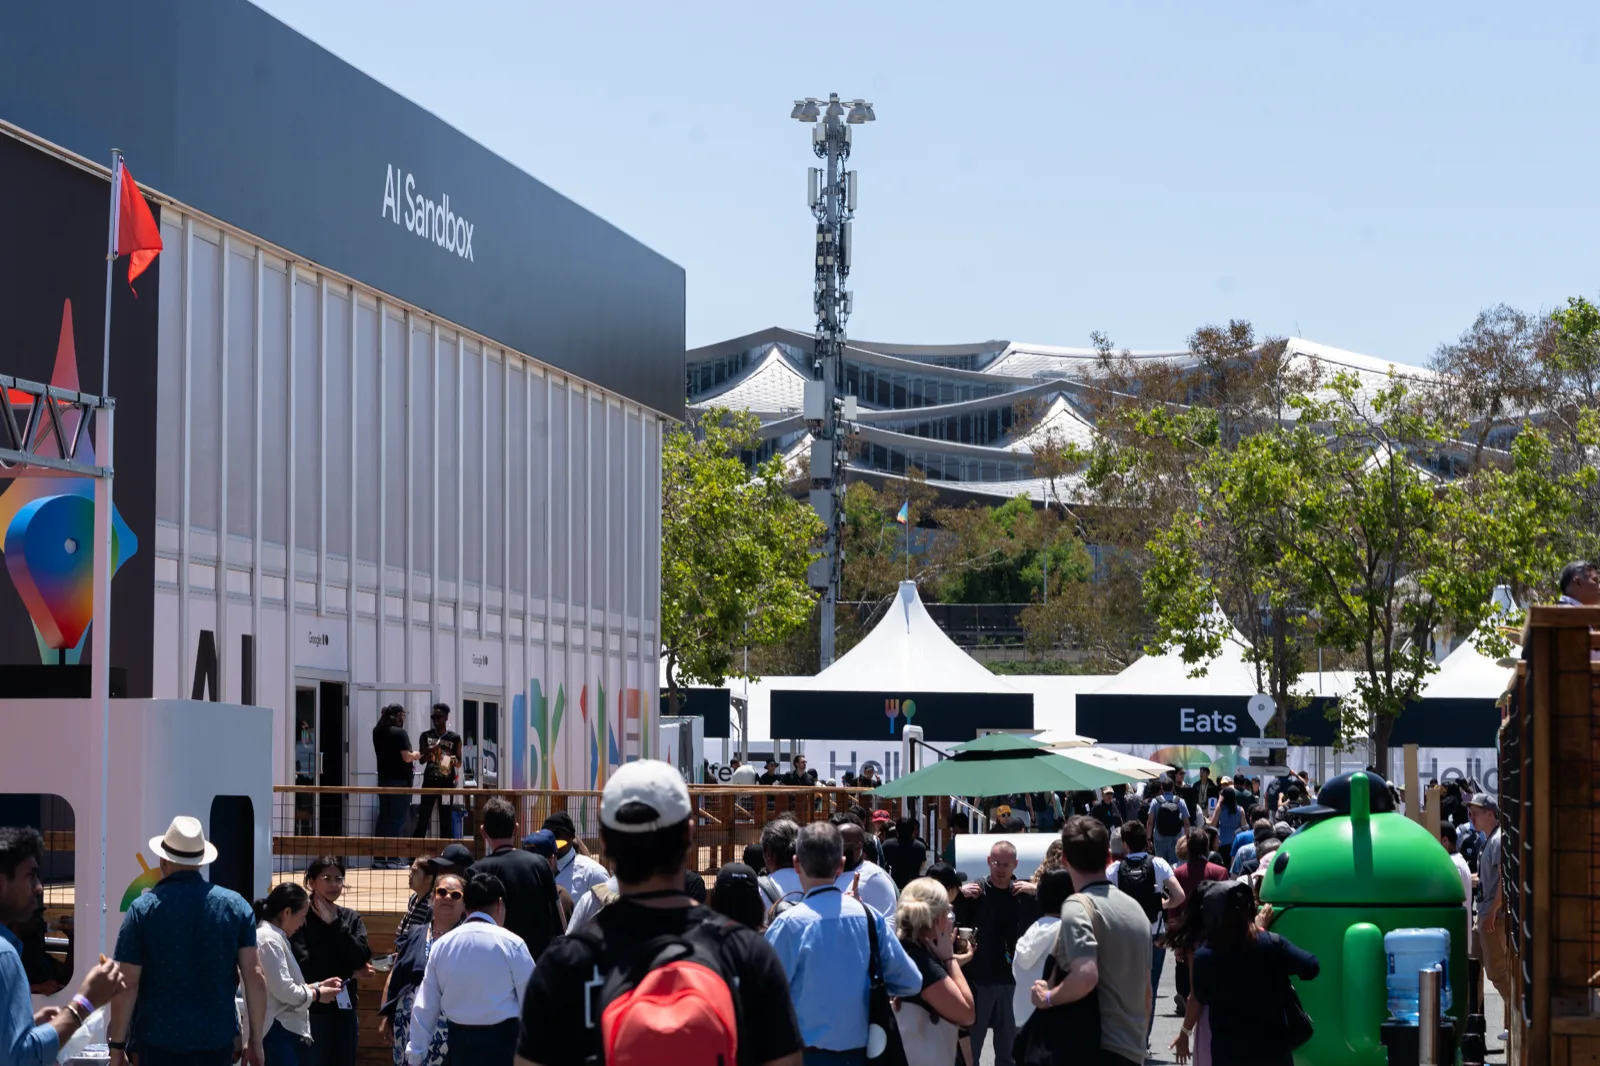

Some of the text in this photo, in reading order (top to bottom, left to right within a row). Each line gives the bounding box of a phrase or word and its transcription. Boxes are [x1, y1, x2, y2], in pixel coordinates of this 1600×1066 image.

[382, 163, 474, 262] AI Sandbox
[308, 630, 321, 647] Google
[472, 653, 482, 667] Google
[1180, 708, 1237, 732] Eats
[830, 751, 900, 784] Hell
